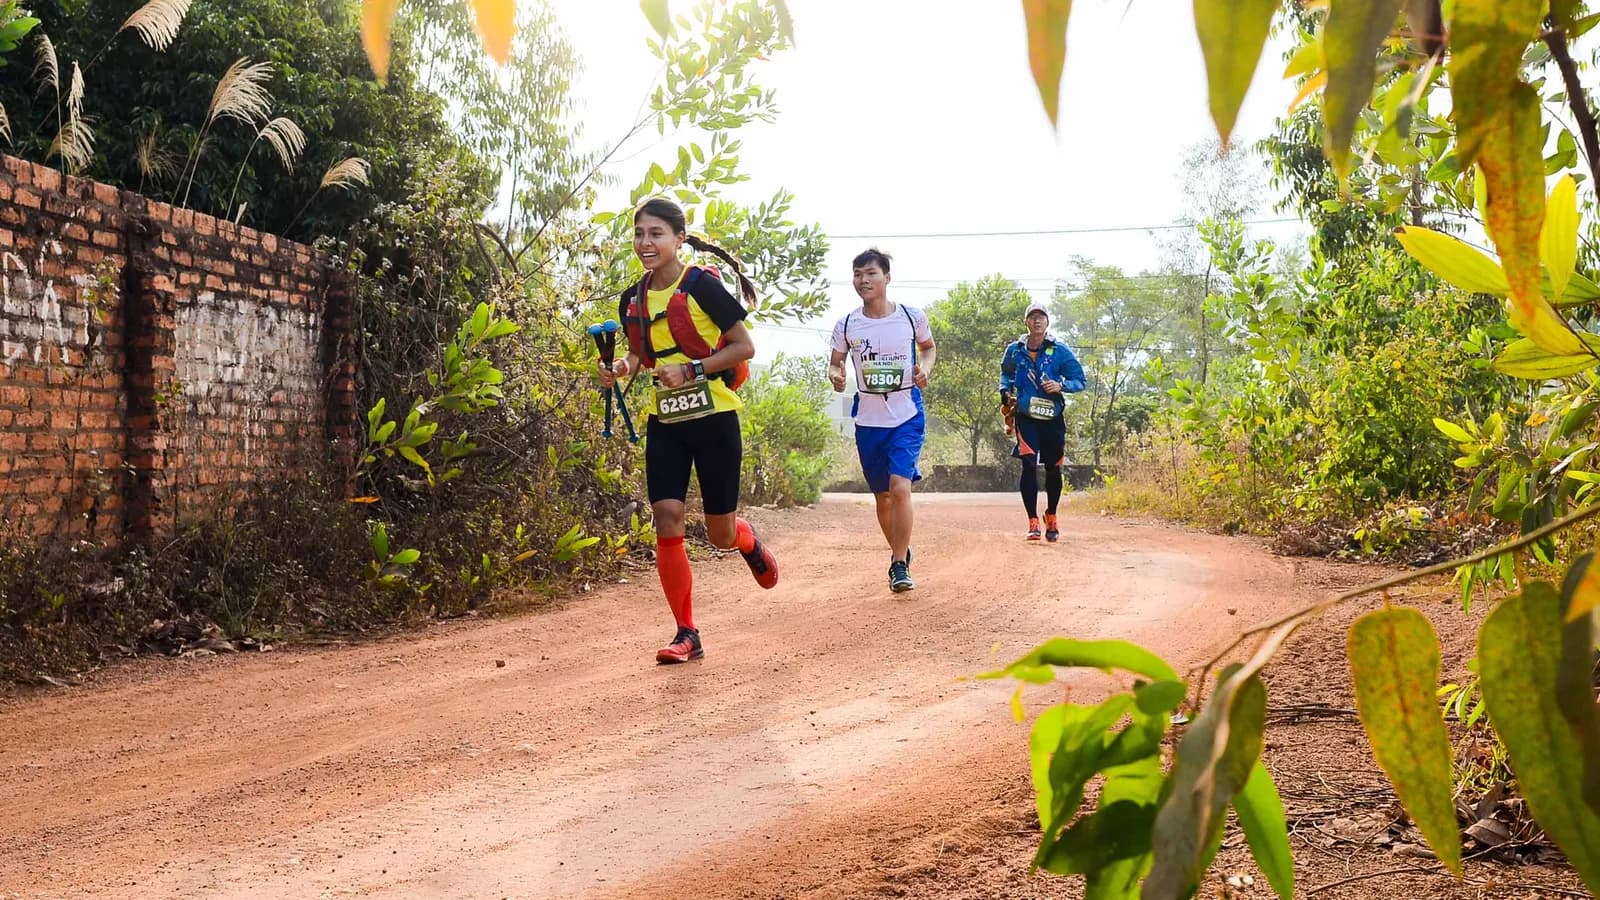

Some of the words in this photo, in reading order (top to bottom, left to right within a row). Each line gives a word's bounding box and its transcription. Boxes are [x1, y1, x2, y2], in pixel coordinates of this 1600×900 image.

[864, 374, 901, 386] 78304
[660, 390, 708, 415] 62821
[1030, 405, 1055, 417] 64932
